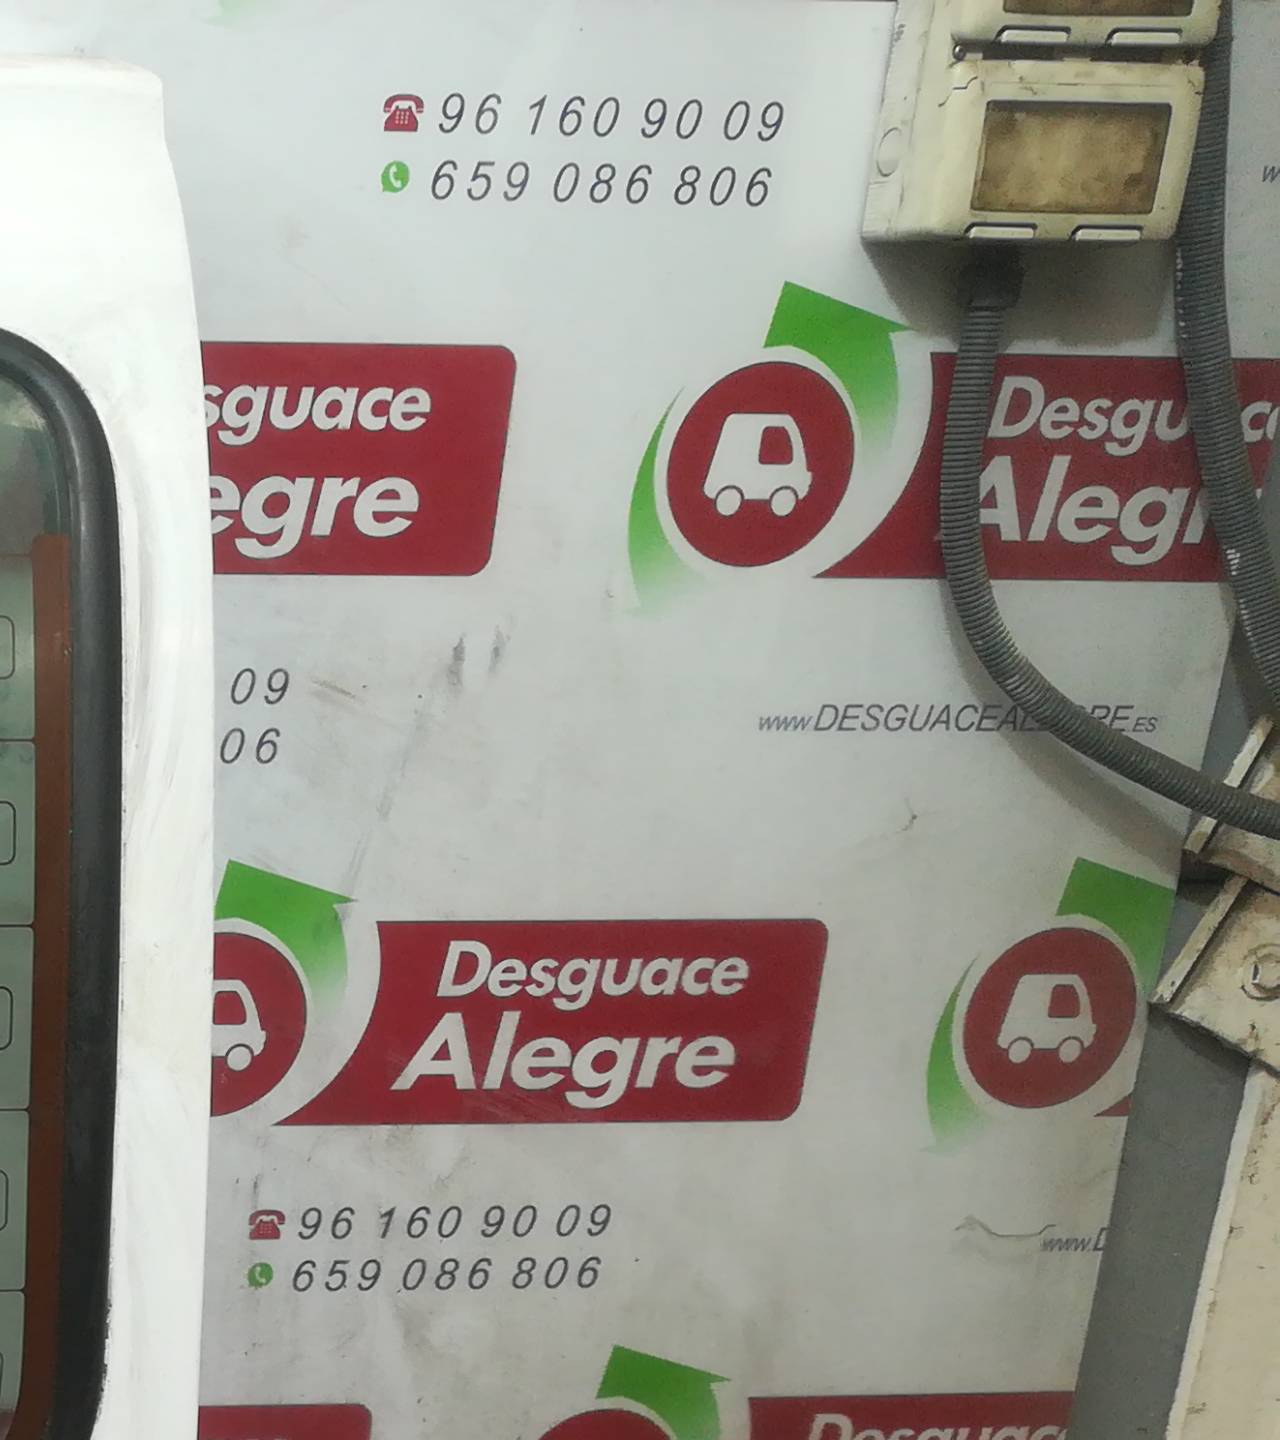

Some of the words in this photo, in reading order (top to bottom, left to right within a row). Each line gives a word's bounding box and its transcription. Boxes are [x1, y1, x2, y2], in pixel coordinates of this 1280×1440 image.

[438, 92, 502, 135] 96
[526, 95, 621, 138] 160
[640, 98, 704, 140] 90
[722, 101, 785, 142] 09
[430, 160, 531, 202] 659
[553, 162, 653, 205] 086
[673, 166, 773, 207] 806
[204, 384, 432, 446] sguace
[209, 475, 420, 560] egre
[229, 667, 290, 706] 09
[219, 727, 282, 765] 06
[436, 940, 750, 1011] Desguace
[389, 1010, 736, 1109] Alegre
[297, 1208, 354, 1241] 96
[378, 1207, 462, 1240] 160
[480, 1206, 537, 1238] 90
[555, 1203, 612, 1236] 09
[291, 1257, 382, 1293] 659
[401, 1257, 491, 1292] 086
[511, 1256, 603, 1290] 806
